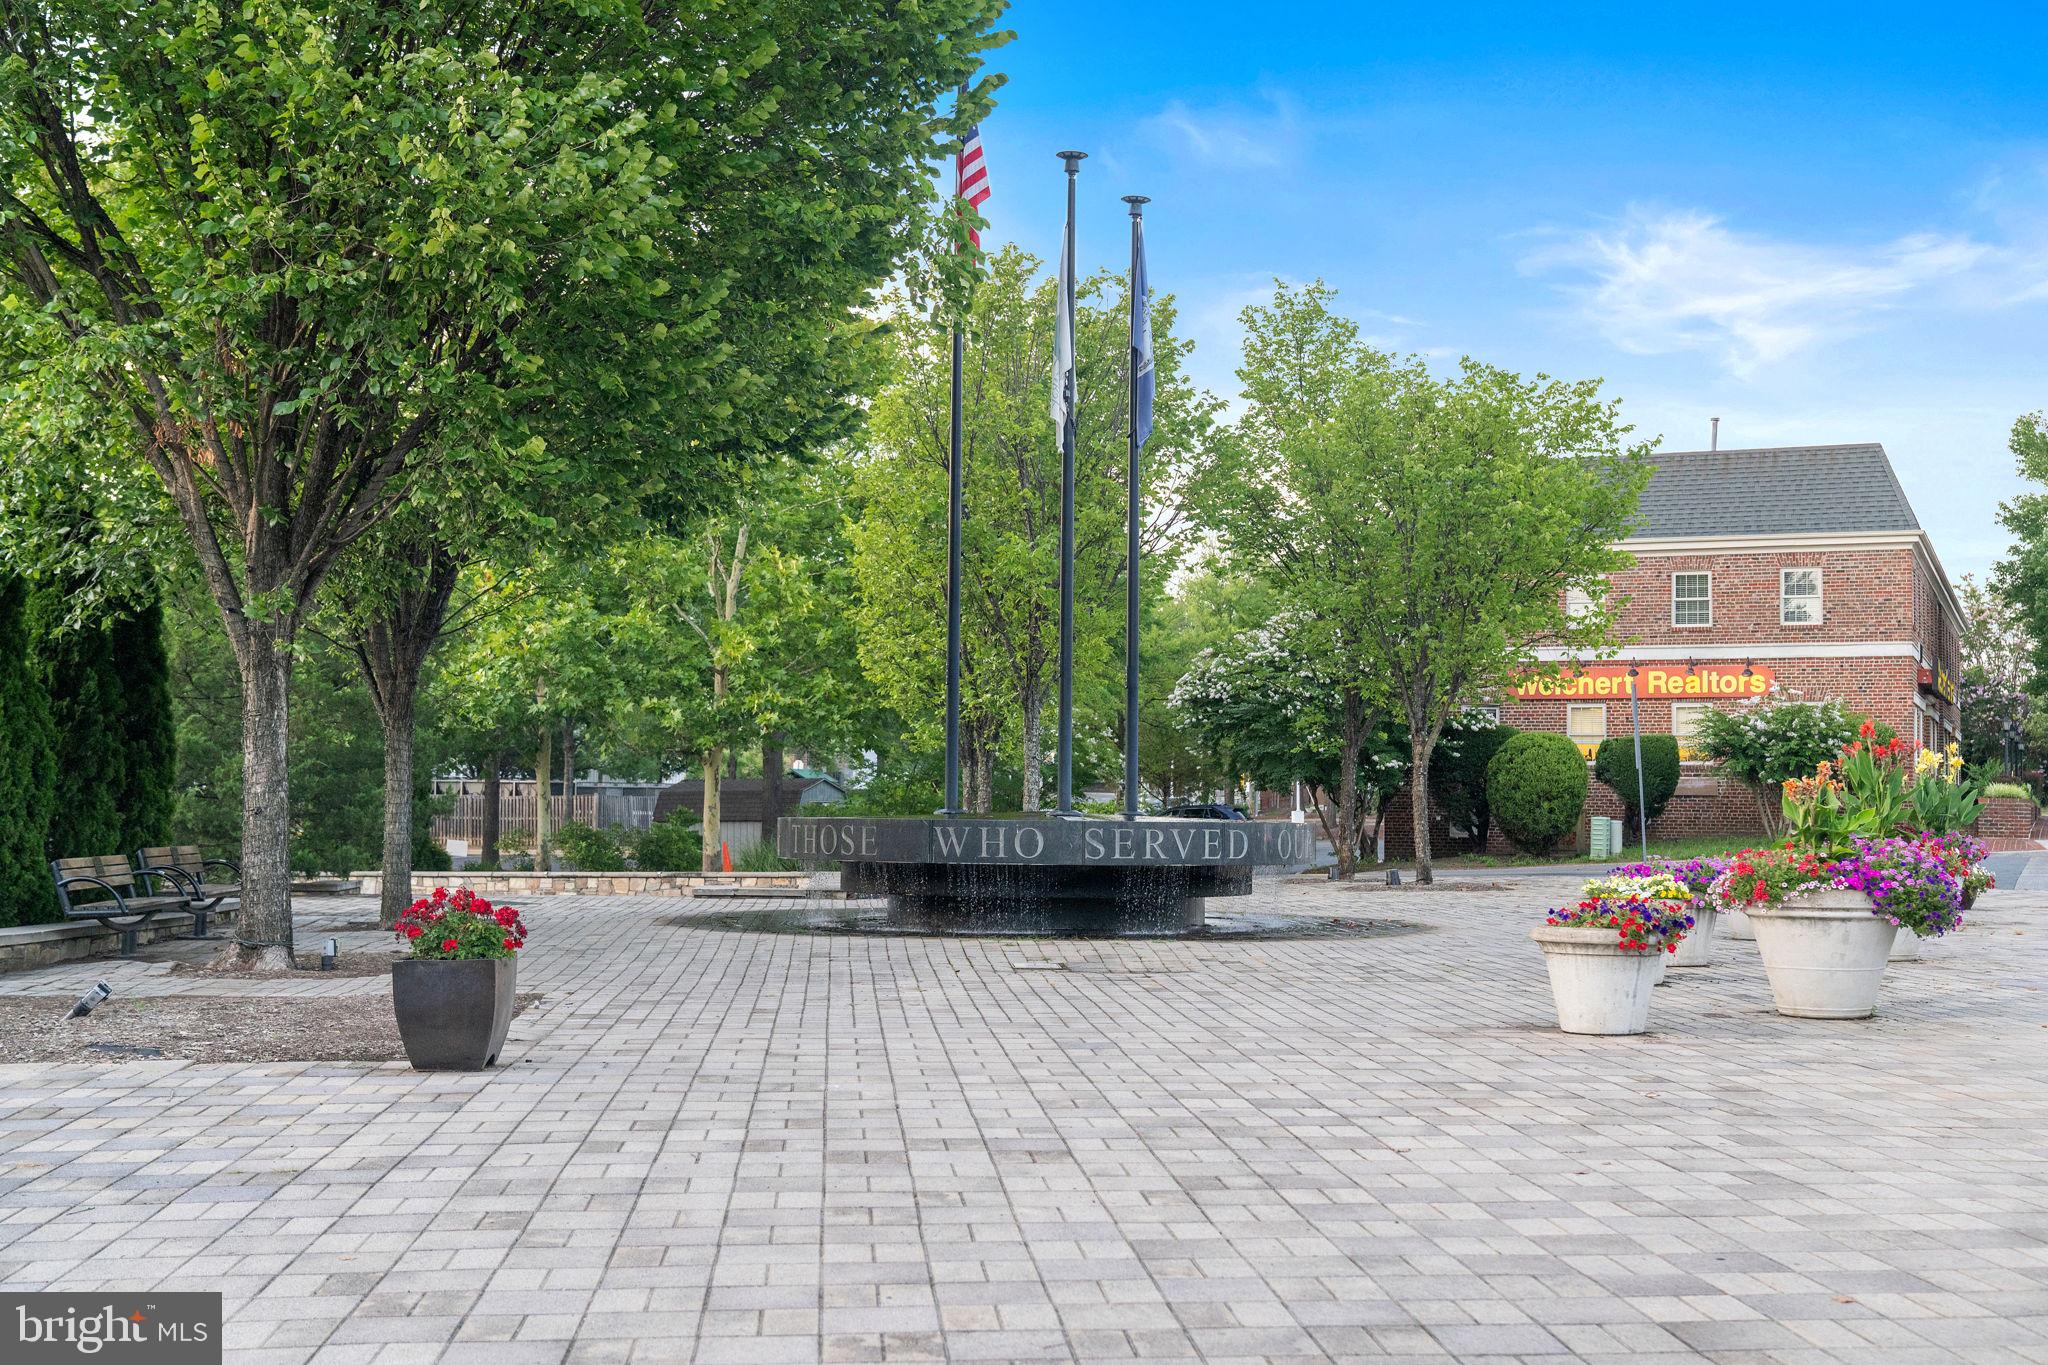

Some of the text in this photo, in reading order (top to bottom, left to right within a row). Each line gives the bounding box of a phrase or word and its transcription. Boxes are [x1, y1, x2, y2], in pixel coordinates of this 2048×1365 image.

[1648, 671, 1766, 694] Realtors
[791, 824, 878, 856] THOSE
[933, 826, 1045, 859] WHO
[1084, 828, 1249, 860] SERVED
